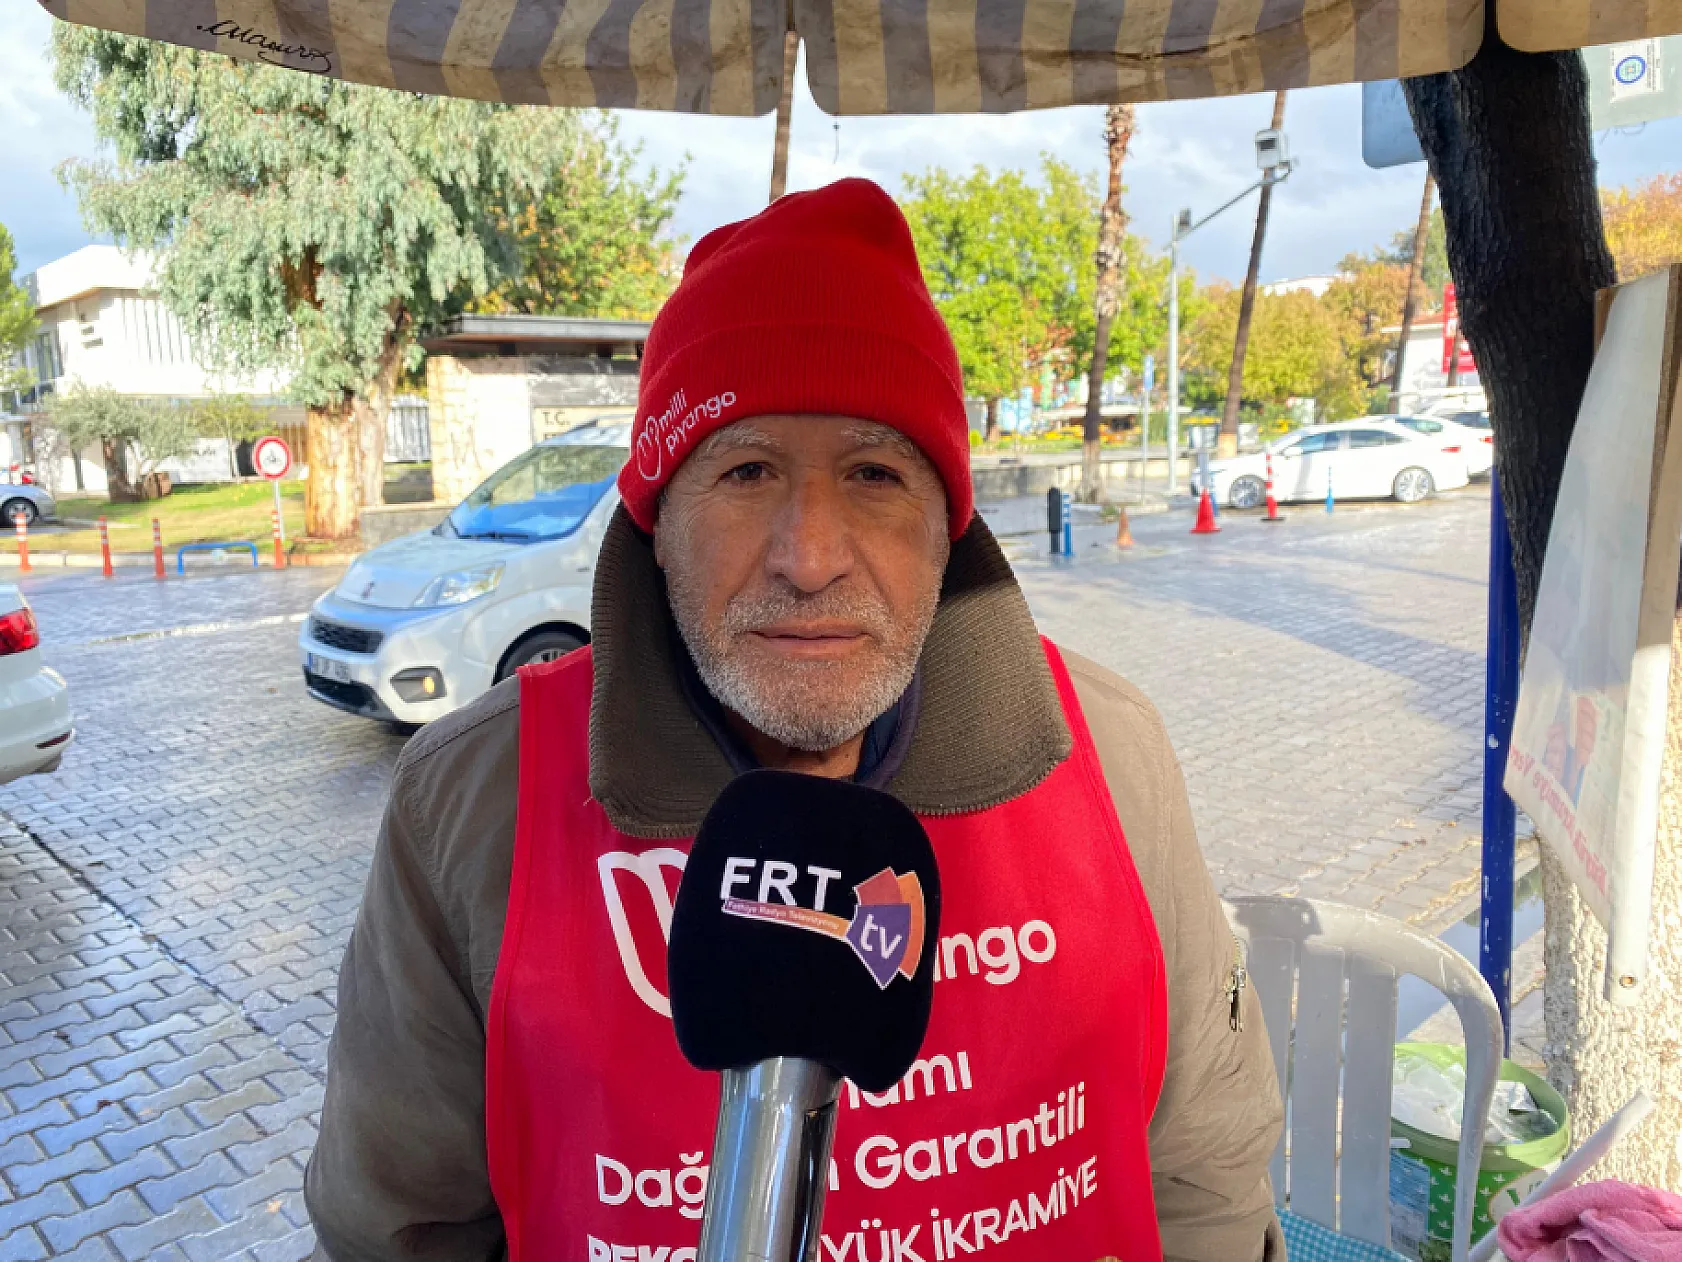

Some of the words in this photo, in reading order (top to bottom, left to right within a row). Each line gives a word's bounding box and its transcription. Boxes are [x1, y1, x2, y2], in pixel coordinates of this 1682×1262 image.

[659, 387, 687, 432] milli
[666, 391, 737, 457] piyango
[720, 856, 842, 912] FRT
[860, 913, 903, 960] tv
[933, 919, 1057, 985] ngo
[595, 1150, 710, 1220] Dağ
[855, 1081, 1085, 1189] Garantili
[817, 1218, 926, 1262] YÜK
[930, 1155, 1098, 1261] İKRAMİYE
